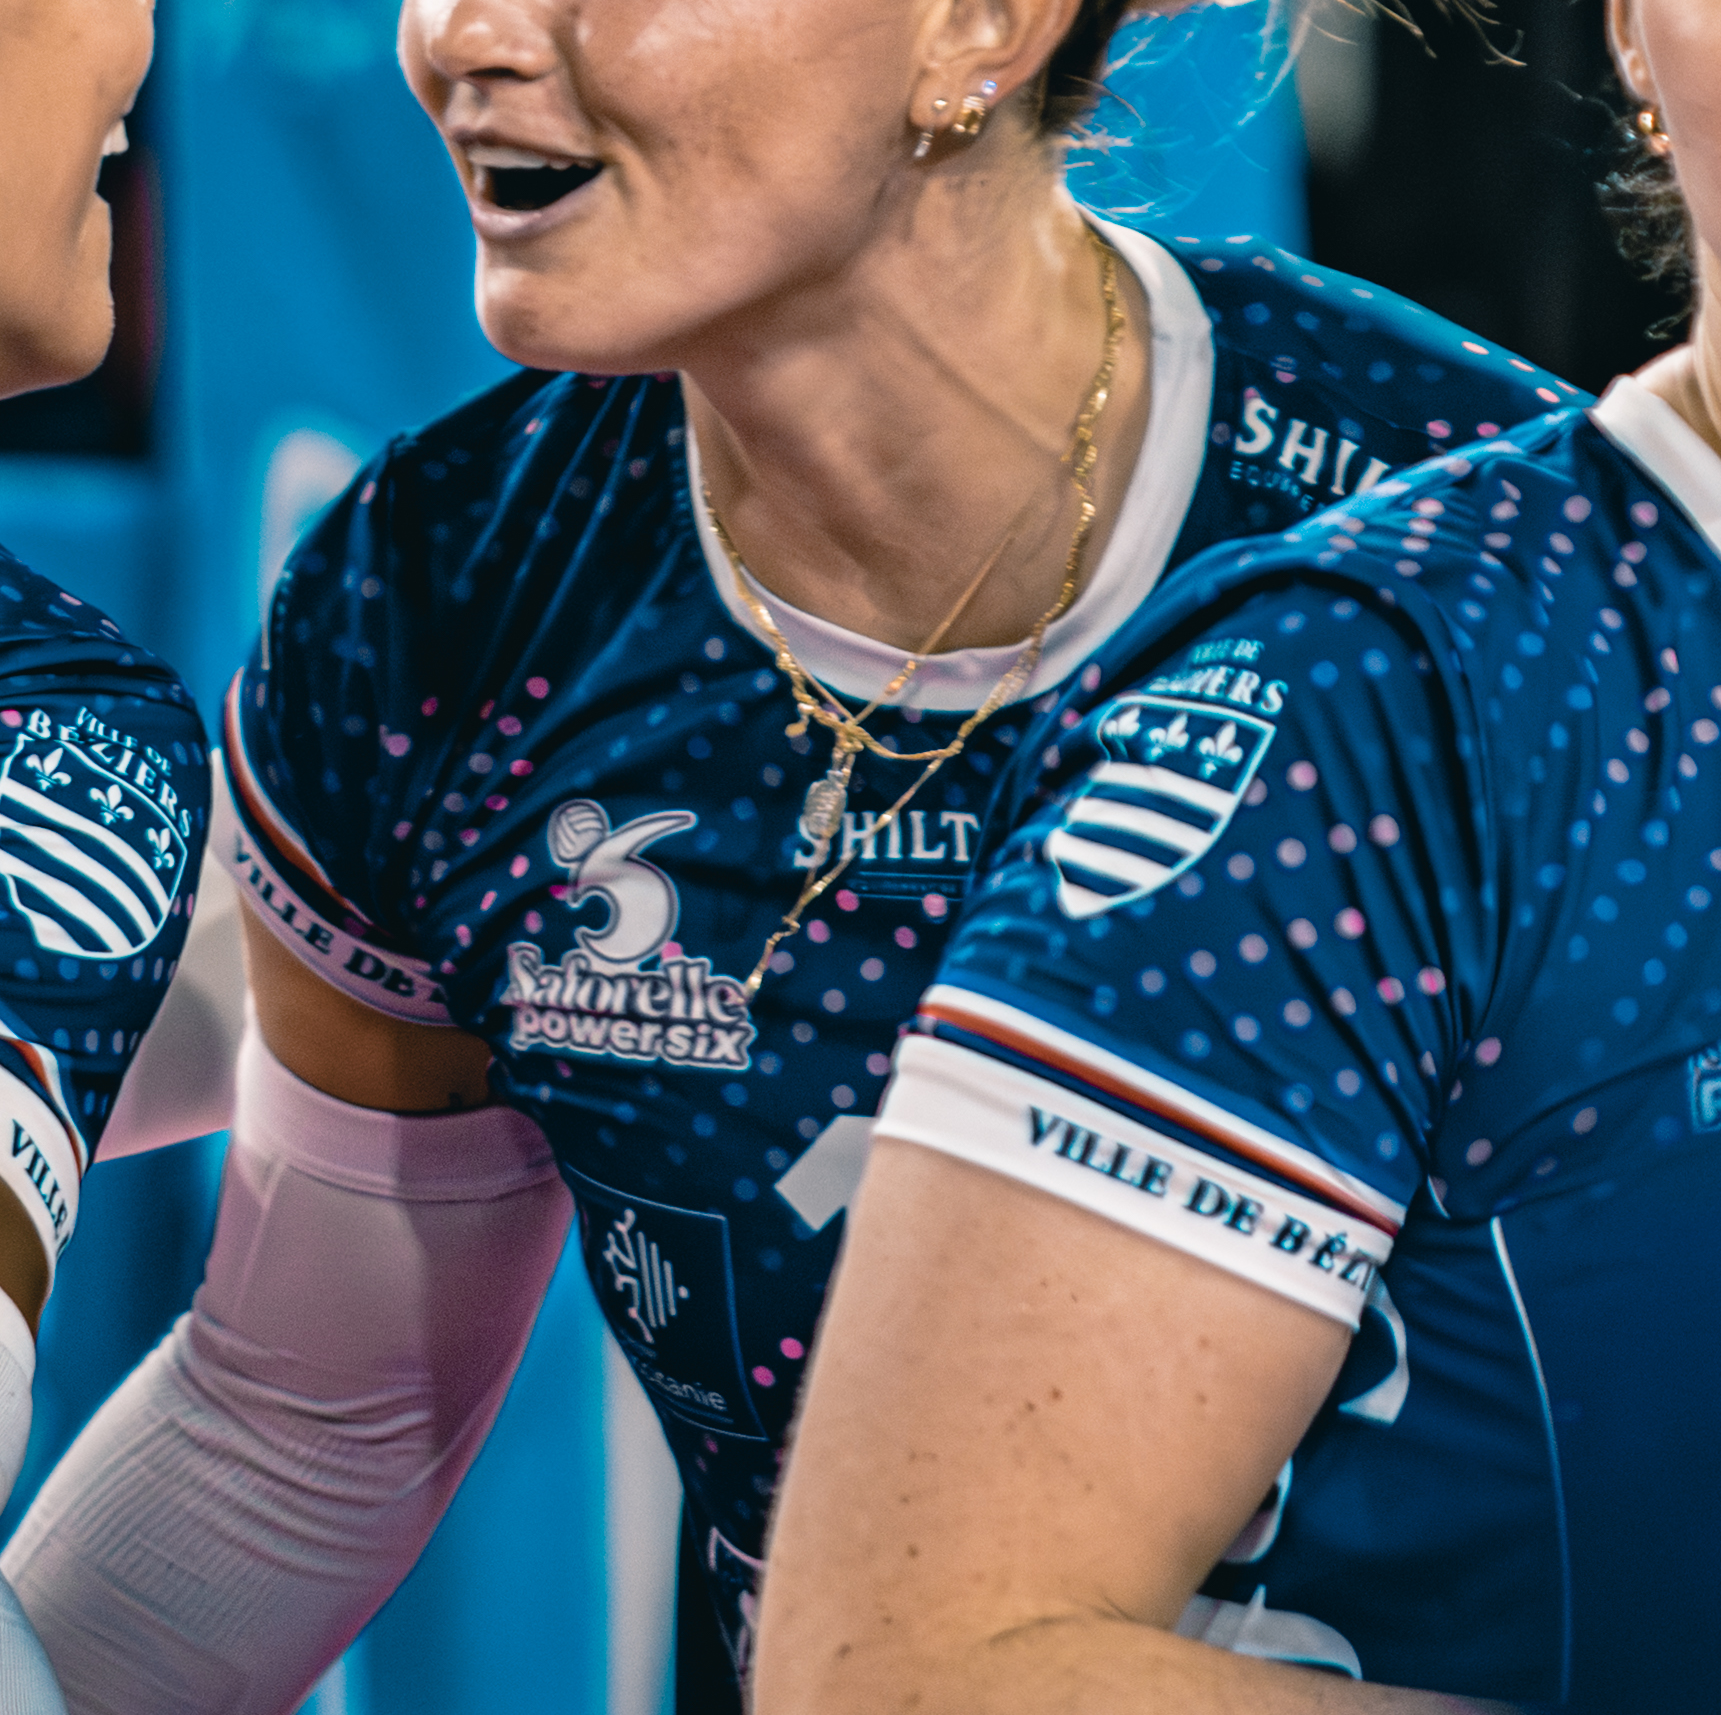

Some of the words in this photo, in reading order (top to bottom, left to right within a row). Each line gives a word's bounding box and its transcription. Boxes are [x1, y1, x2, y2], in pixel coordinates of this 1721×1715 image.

[75, 705, 139, 749] VILLE
[144, 745, 173, 778] DE
[793, 809, 980, 869] SHILT
[342, 946, 416, 997] DE
[515, 1005, 748, 1063] powersix
[1027, 1103, 1175, 1200] VILLE
[1182, 1175, 1266, 1237] DE
